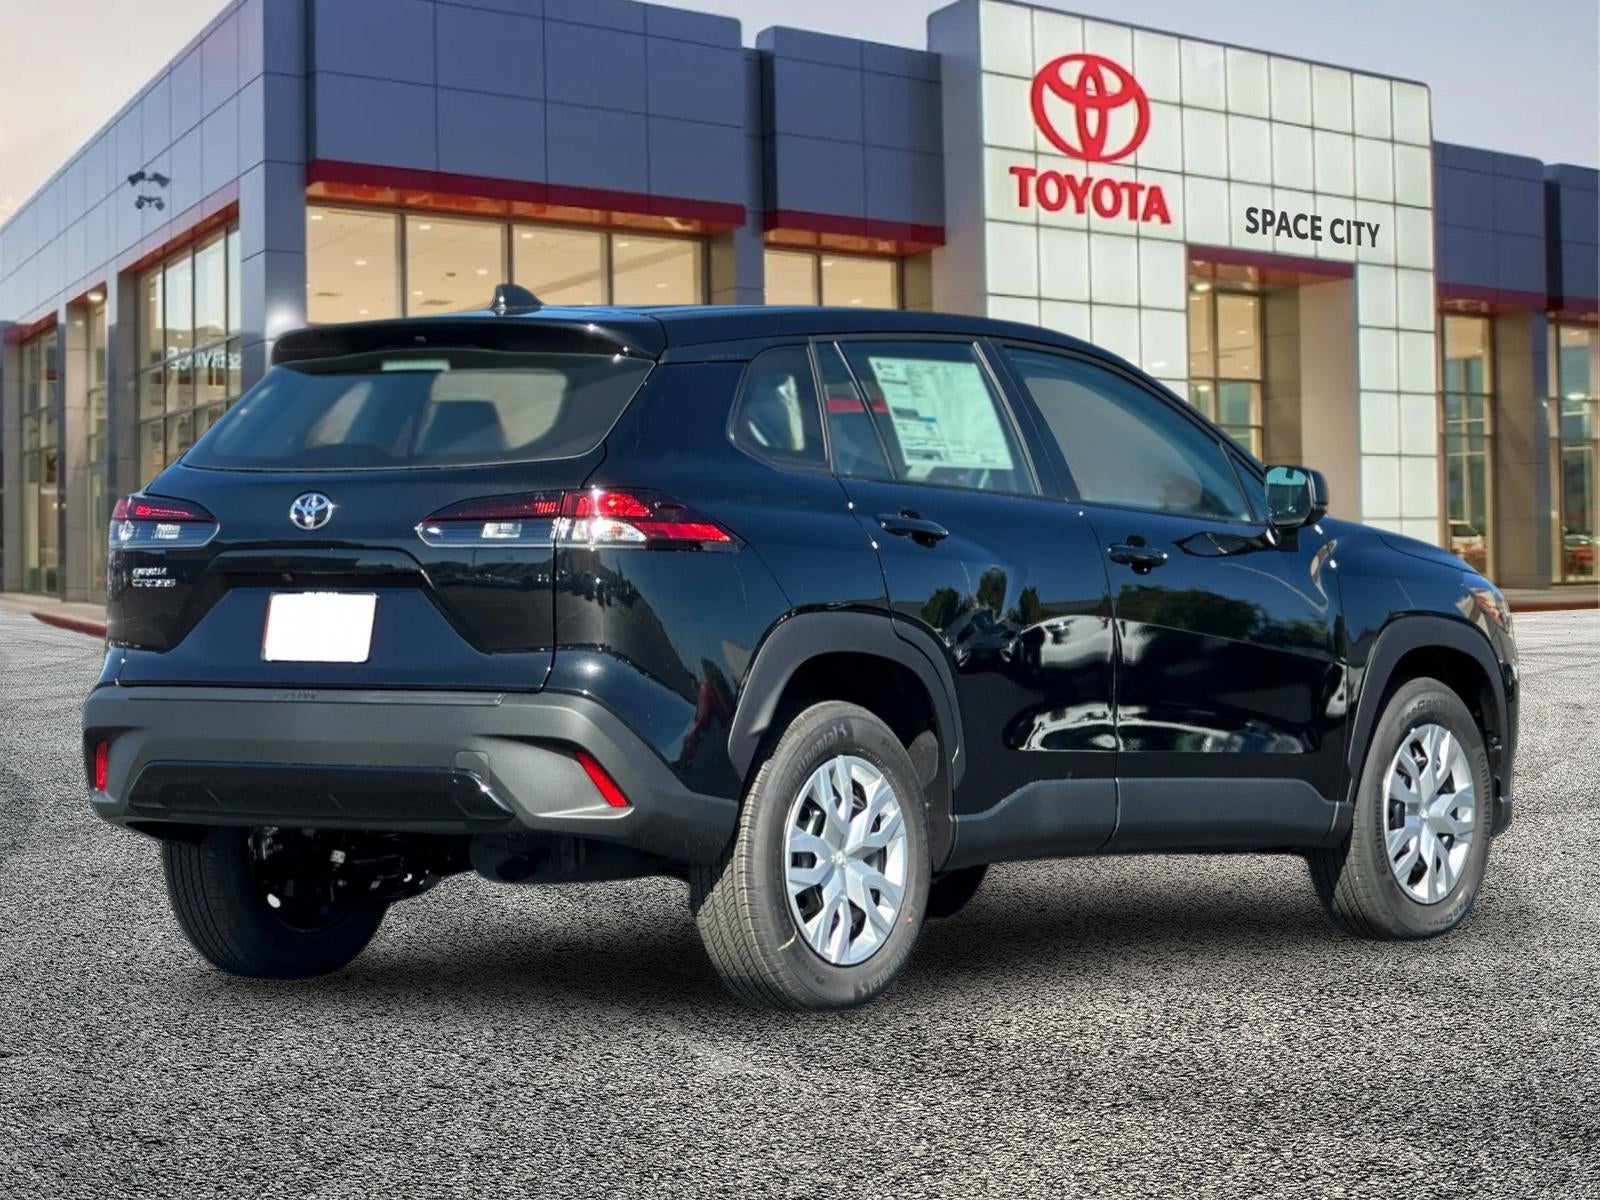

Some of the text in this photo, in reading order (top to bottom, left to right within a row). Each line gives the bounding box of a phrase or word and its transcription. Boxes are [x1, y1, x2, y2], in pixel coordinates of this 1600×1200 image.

[1009, 166, 1171, 224] TOYOTA
[1245, 206, 1380, 248] SPACE CITY
